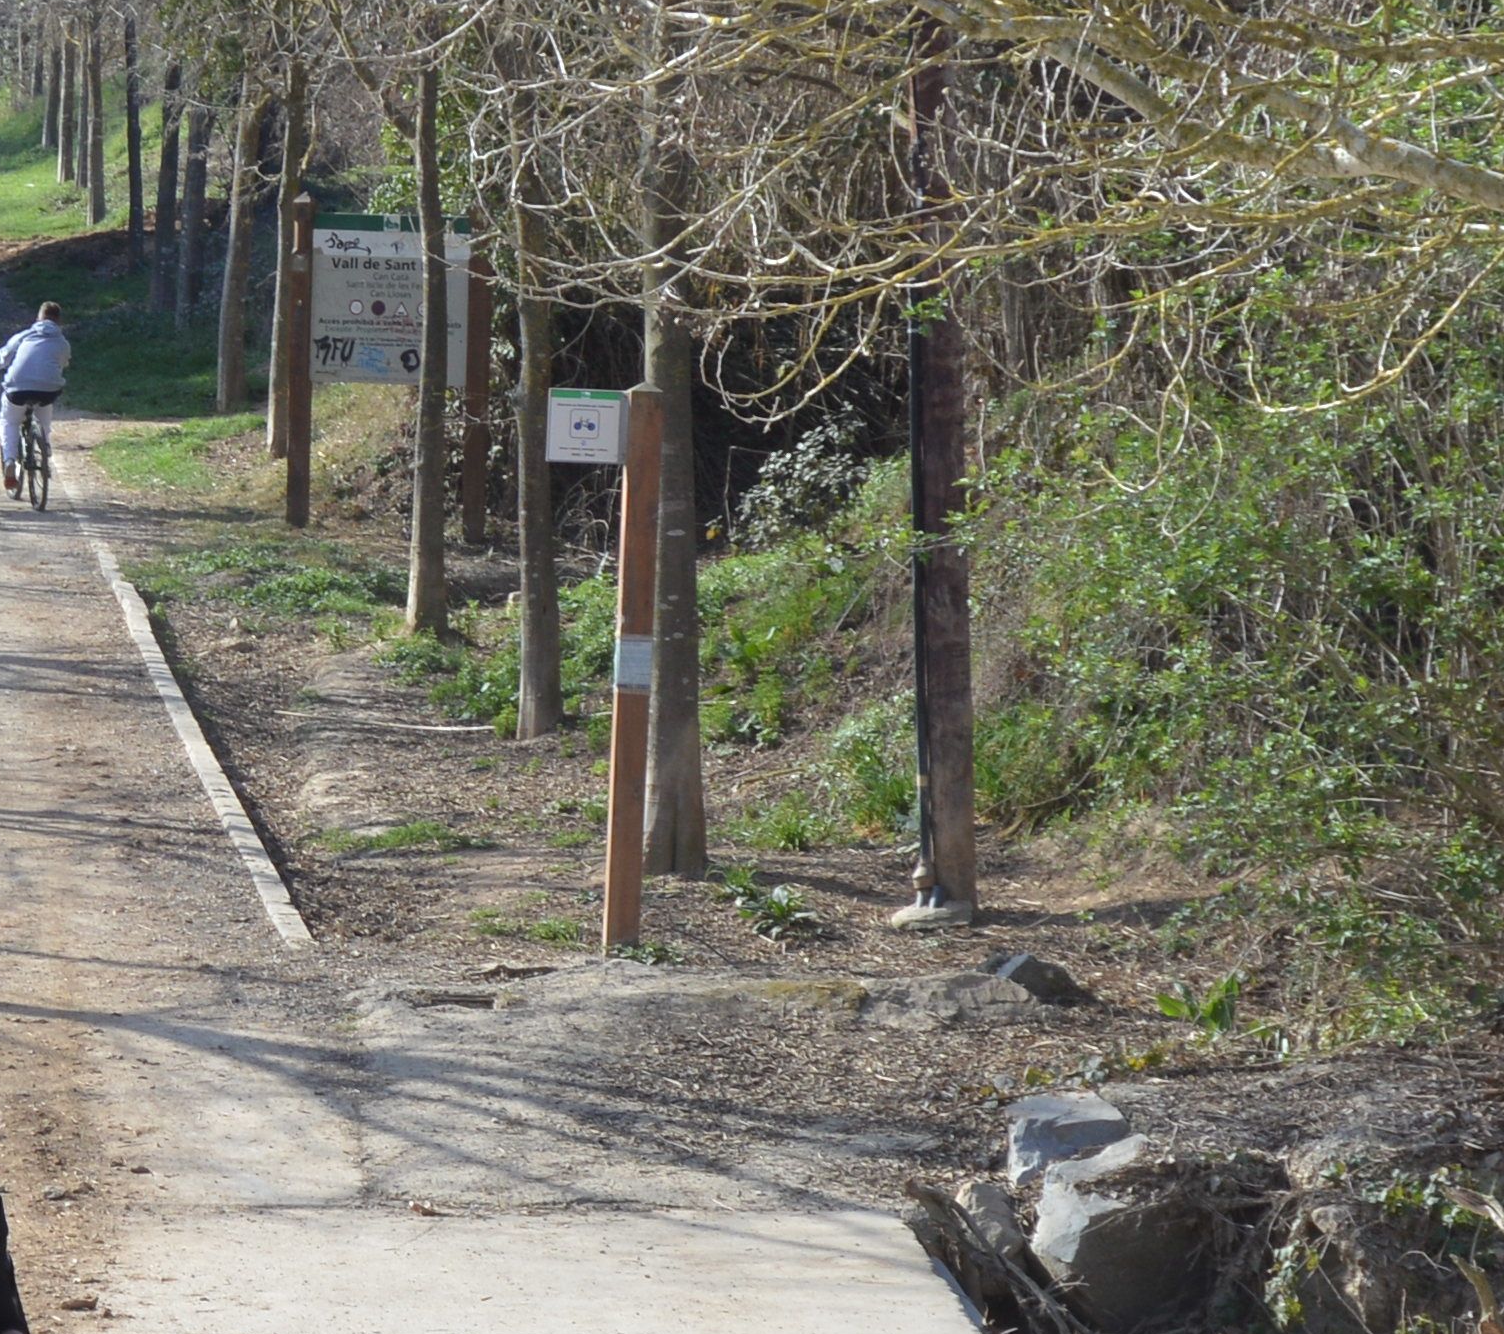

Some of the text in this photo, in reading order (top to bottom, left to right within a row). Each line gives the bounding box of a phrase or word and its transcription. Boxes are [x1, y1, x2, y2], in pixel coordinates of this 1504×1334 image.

[332, 257, 359, 270] Vall
[363, 258, 381, 271] de
[385, 259, 417, 272] Sant
